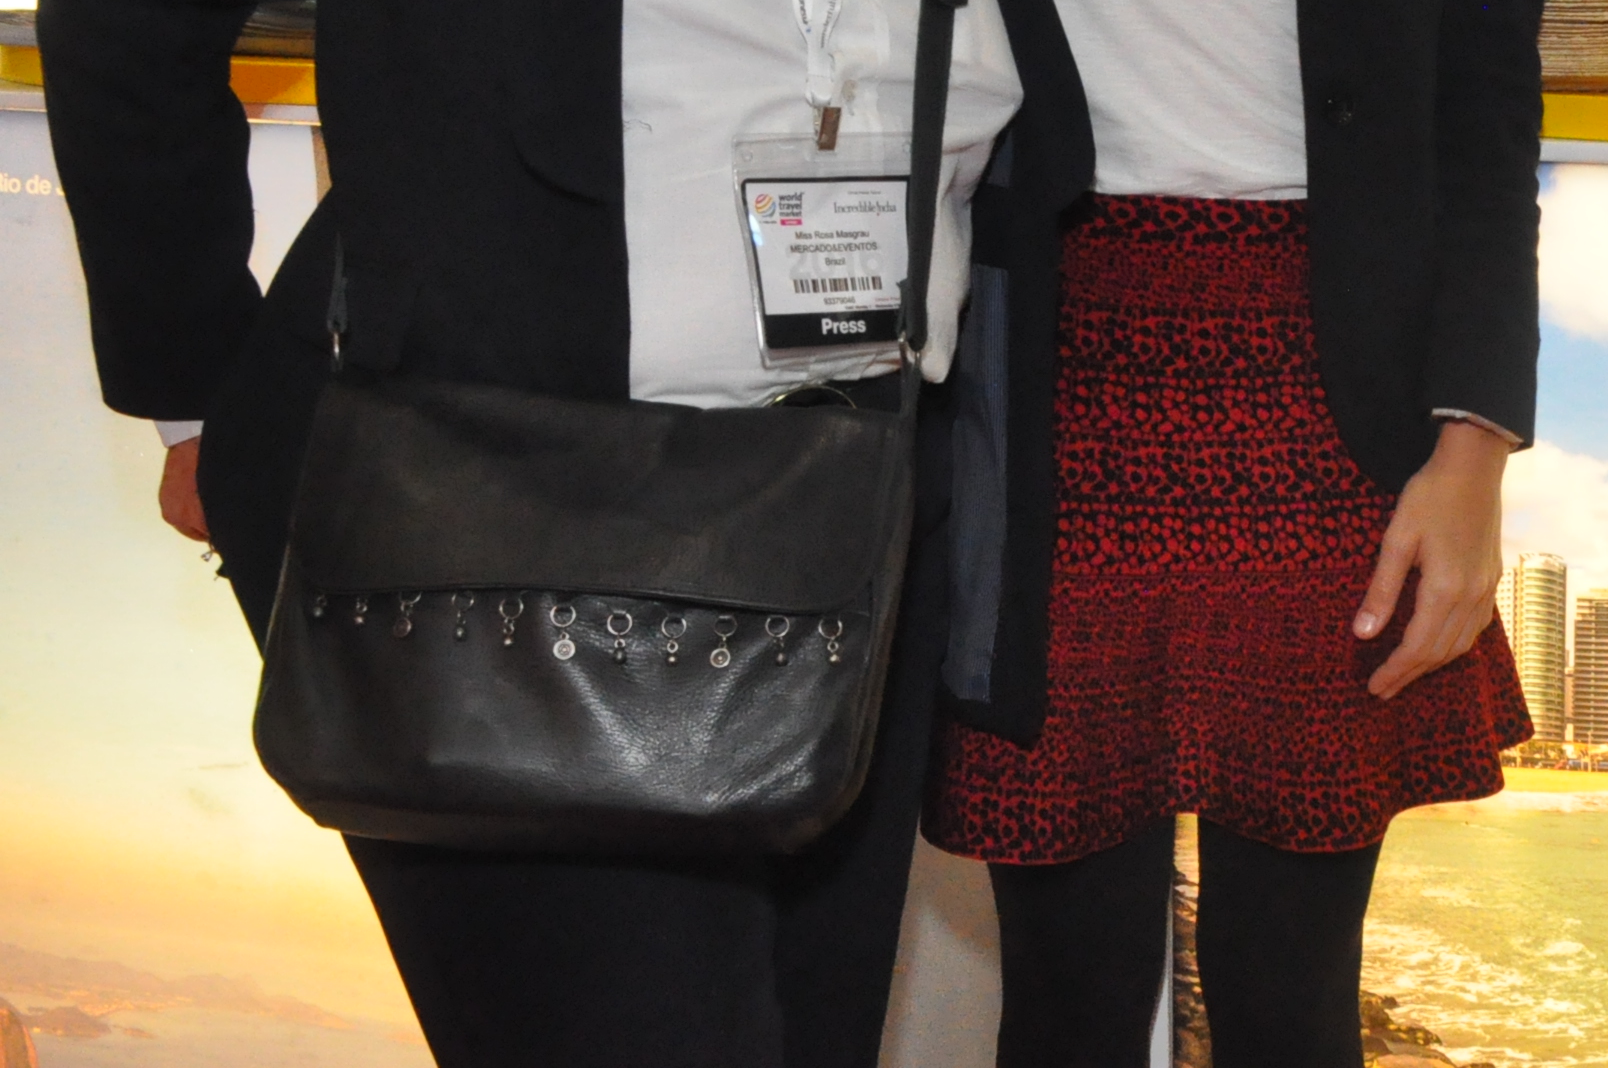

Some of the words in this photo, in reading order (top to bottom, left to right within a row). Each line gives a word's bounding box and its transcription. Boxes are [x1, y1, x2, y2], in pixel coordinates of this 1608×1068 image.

[0, 173, 21, 193] io
[26, 174, 52, 195] de
[779, 192, 802, 201] world
[779, 201, 802, 210] travel
[779, 210, 802, 218] market
[795, 231, 813, 240] Miss
[815, 230, 834, 239] Rosa
[825, 257, 846, 266] Brazil
[821, 317, 867, 336] Press
